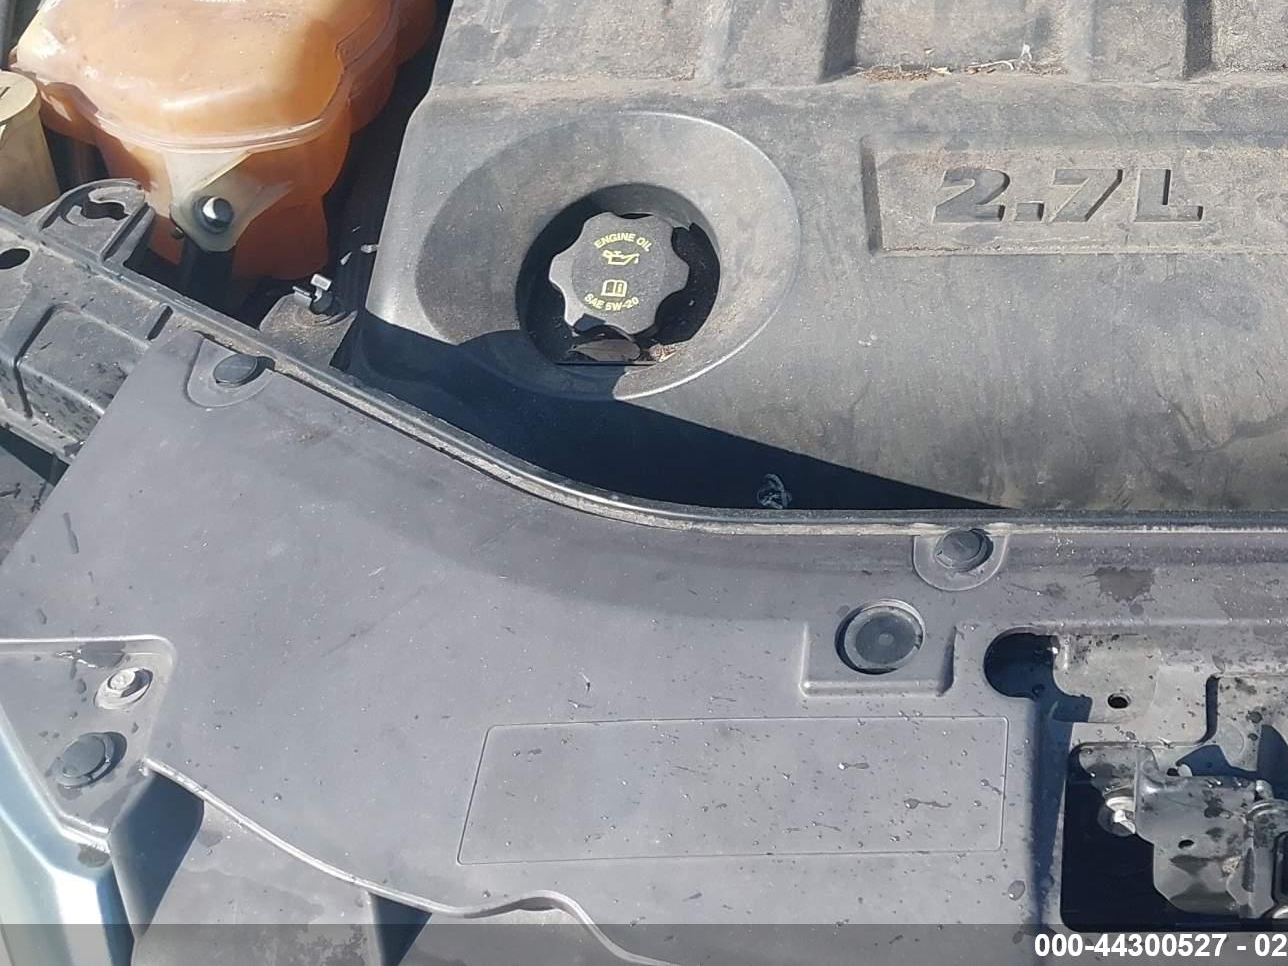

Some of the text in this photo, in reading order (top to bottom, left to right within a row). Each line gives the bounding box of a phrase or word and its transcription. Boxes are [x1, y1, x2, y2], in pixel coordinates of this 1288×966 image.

[931, 168, 1204, 223] 2.7L
[594, 232, 653, 252] ENGINE OIL
[584, 293, 639, 311] SAE 5W-20
